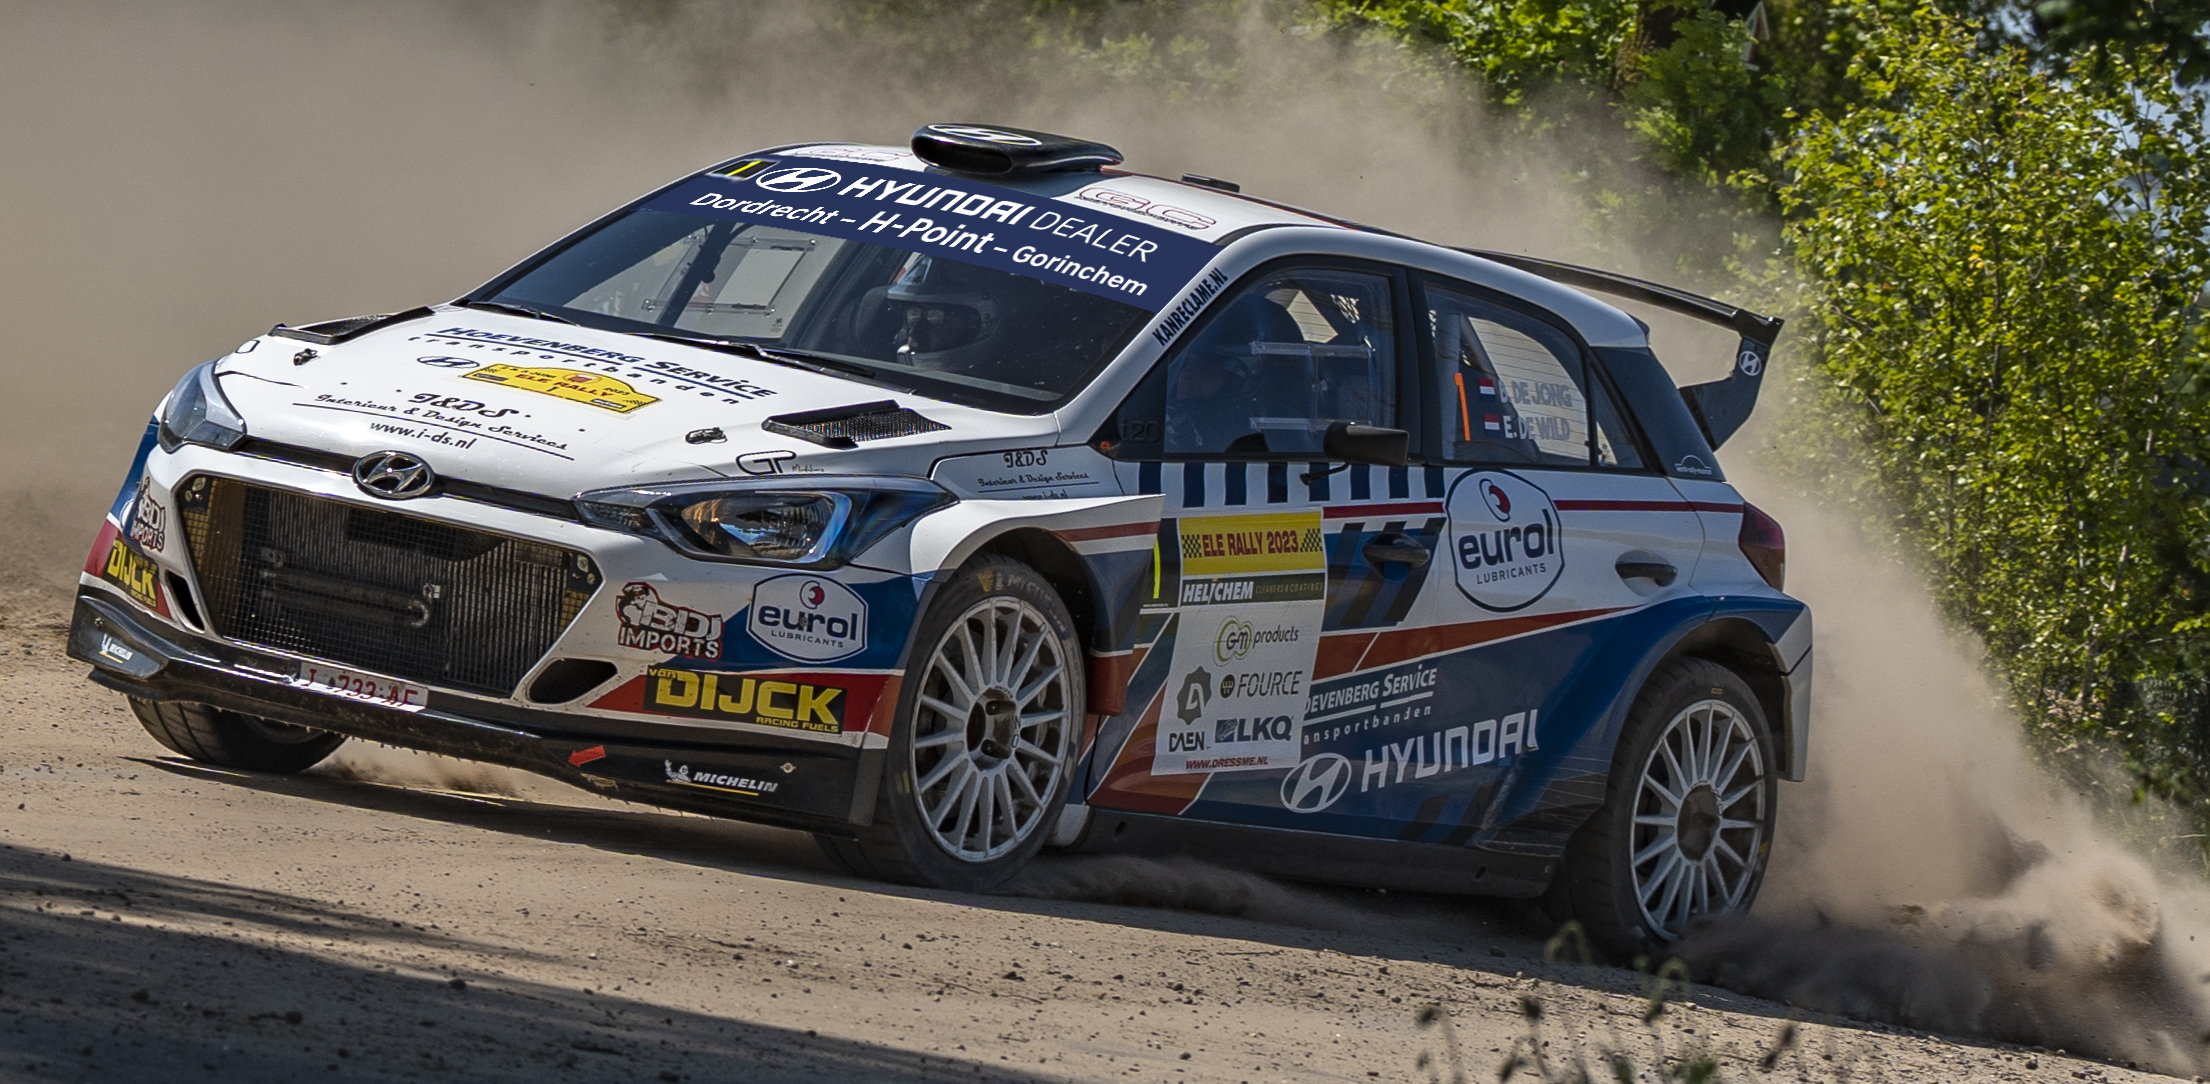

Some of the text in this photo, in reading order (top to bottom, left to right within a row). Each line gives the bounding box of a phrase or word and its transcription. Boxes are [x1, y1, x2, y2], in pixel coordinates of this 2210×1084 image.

[836, 176, 1036, 226] HYUNDAI
[1029, 211, 1160, 263] DEALER
[689, 192, 840, 225] Dordrecht
[856, 211, 995, 254] H-Point
[1011, 245, 1149, 296] Gorinchem
[1151, 266, 1229, 347] KANRECLAME.NL
[435, 327, 646, 363] HOEVENBERG
[514, 373, 552, 384] ELE
[552, 381, 613, 397] RALLY
[1512, 380, 1531, 405] DE
[1531, 382, 1573, 407] JONG
[1454, 372, 1471, 441] 1
[314, 394, 568, 450] Interieur & Design Services
[370, 422, 478, 450] www.i-ds.nl
[1503, 415, 1571, 440] E. DE WILD
[1202, 529, 1300, 558] ELE RALLY 2023
[1458, 508, 1555, 570] eurol
[1476, 562, 1547, 585] LUBRICANTS
[758, 605, 858, 641] eurol
[1253, 624, 1299, 650] products
[619, 625, 721, 659] IMPORTS
[770, 629, 844, 648] LUBRICANTS
[648, 668, 678, 680] van
[1236, 670, 1304, 699] FOURCE
[655, 669, 843, 725] DIJCK
[755, 717, 839, 733] RACING FUELS
[1236, 715, 1293, 742] LKQ
[1303, 705, 1432, 745] ansportbanden
[1168, 731, 1206, 753] DAEN
[1360, 709, 1540, 793] HYUNDAI
[1185, 756, 1269, 770] WWW.DRESSME.NL
[693, 771, 779, 793] MICHELIN
